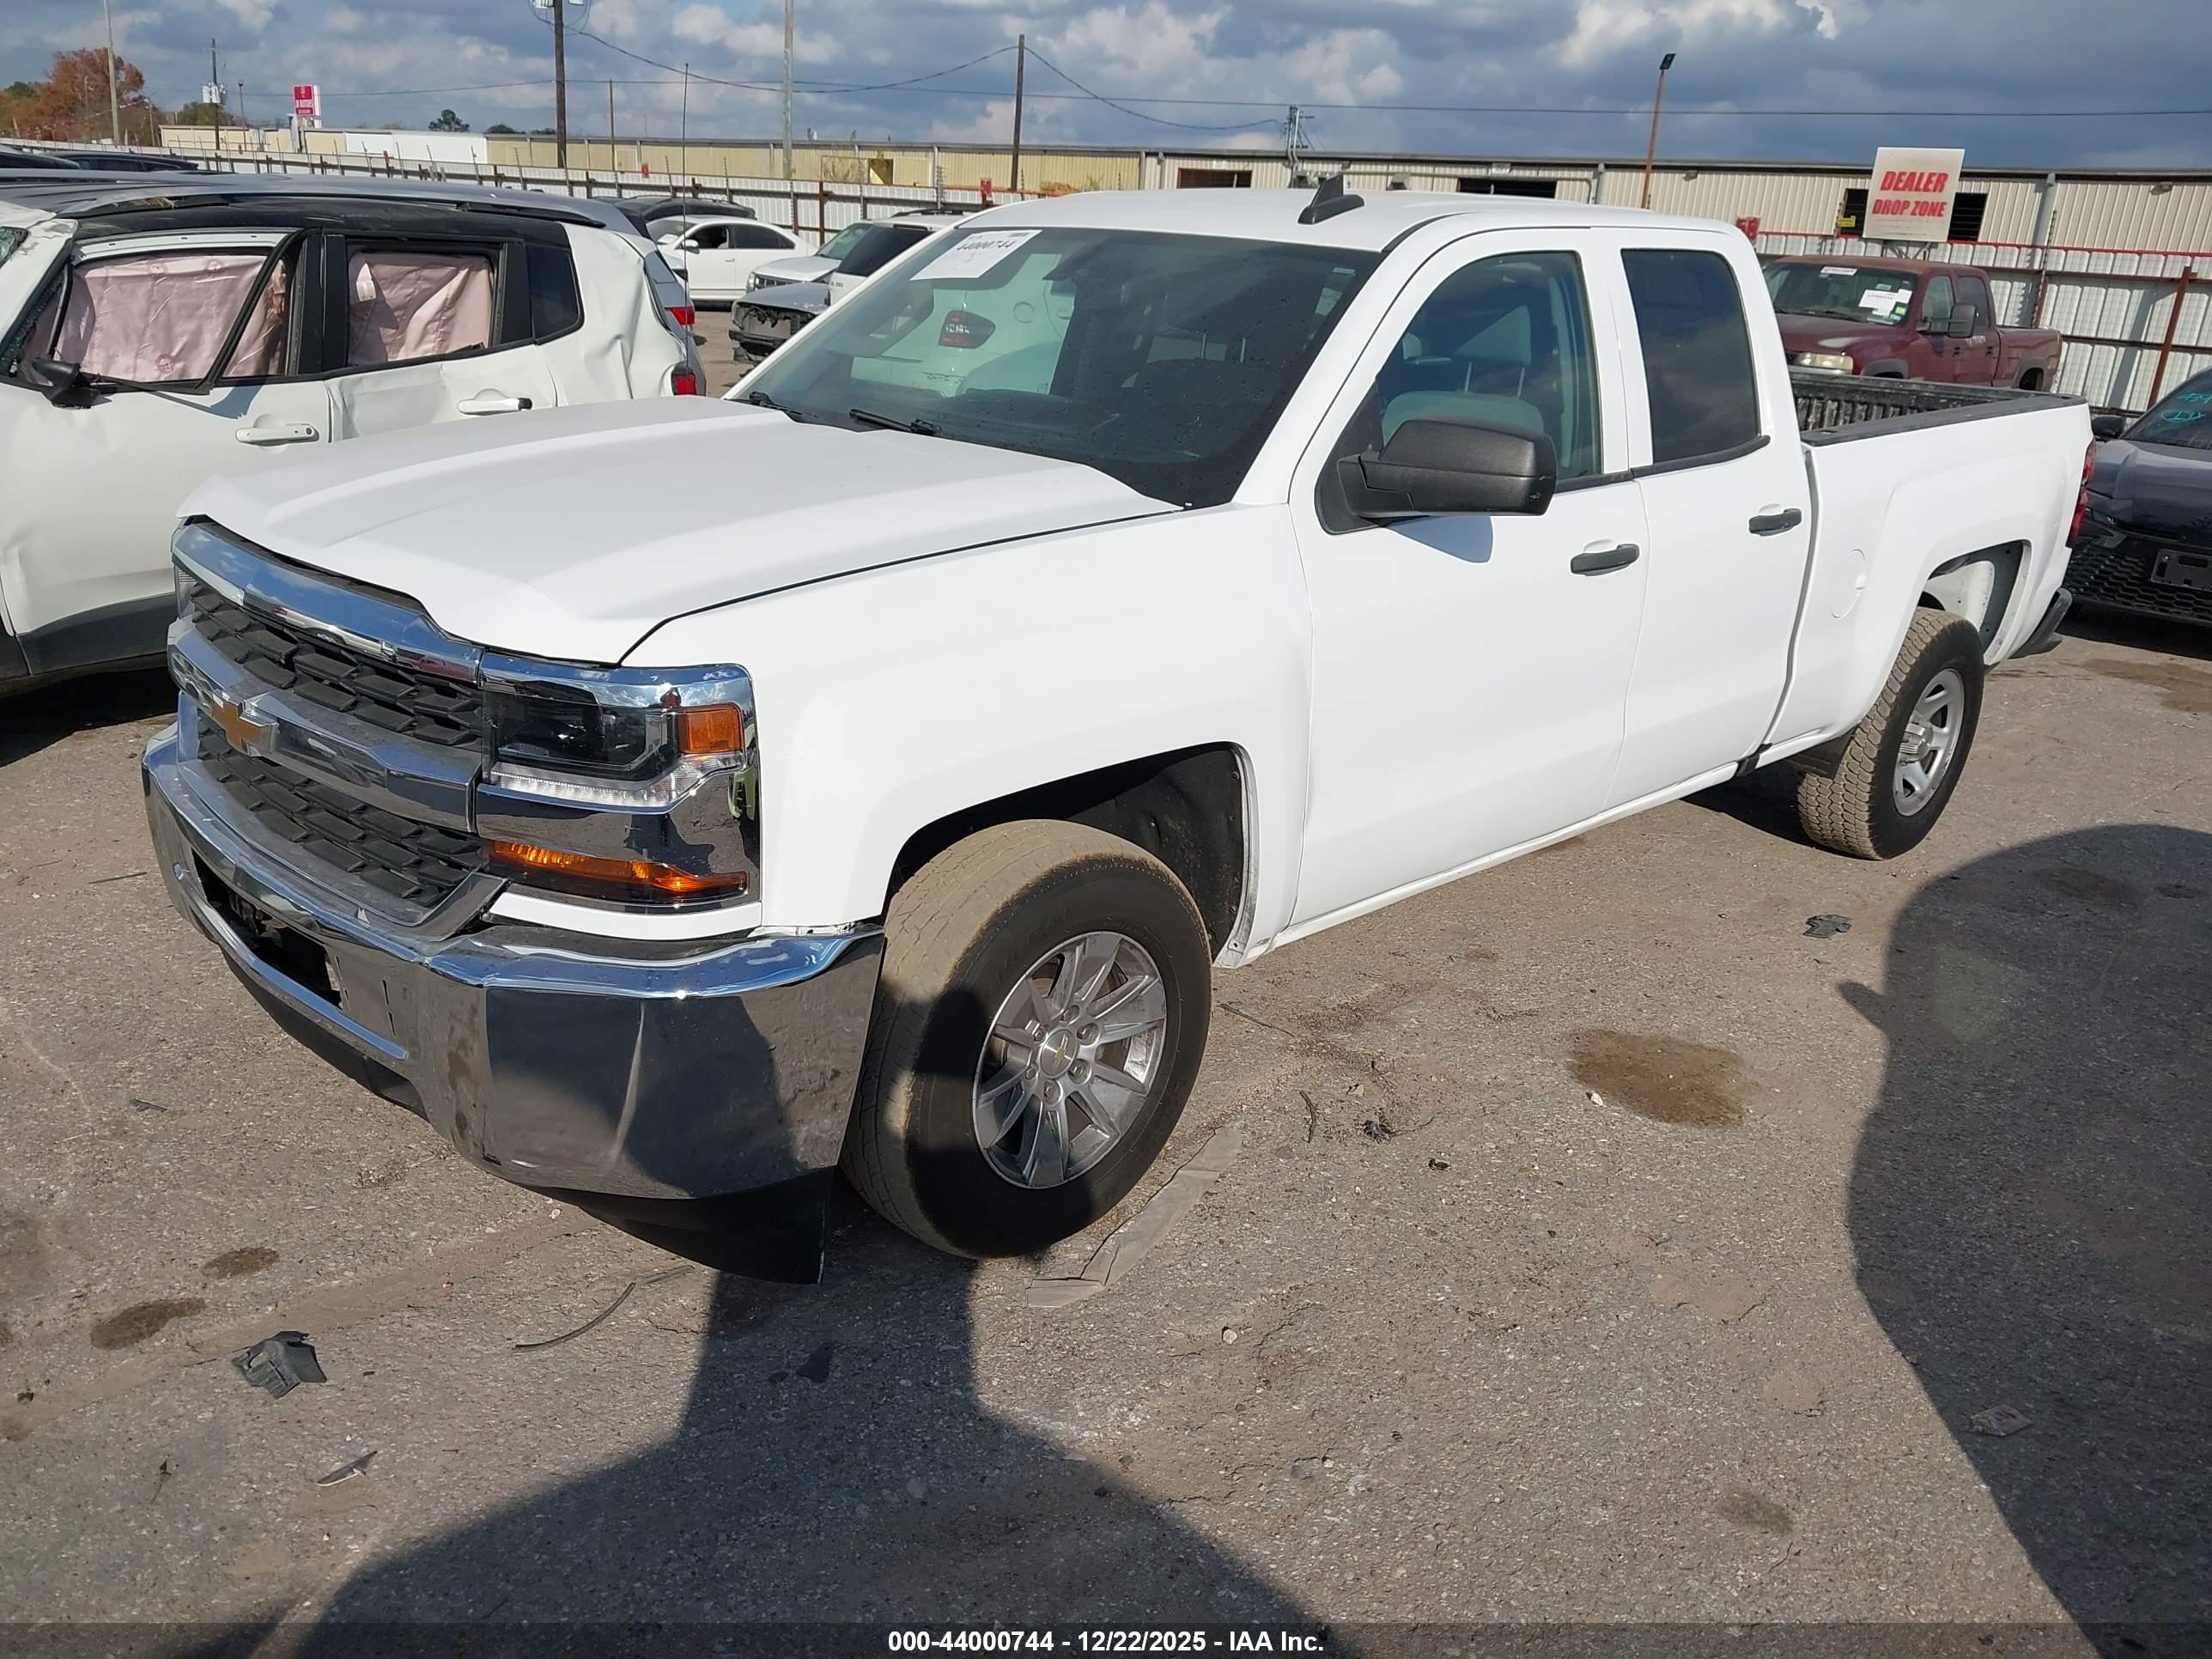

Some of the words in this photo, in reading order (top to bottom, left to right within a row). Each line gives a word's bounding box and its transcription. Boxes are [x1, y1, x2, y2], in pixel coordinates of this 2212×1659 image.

[1881, 171, 1948, 193] DEALER
[1872, 199, 1911, 216] DROP
[1910, 201, 1947, 216] ZONE
